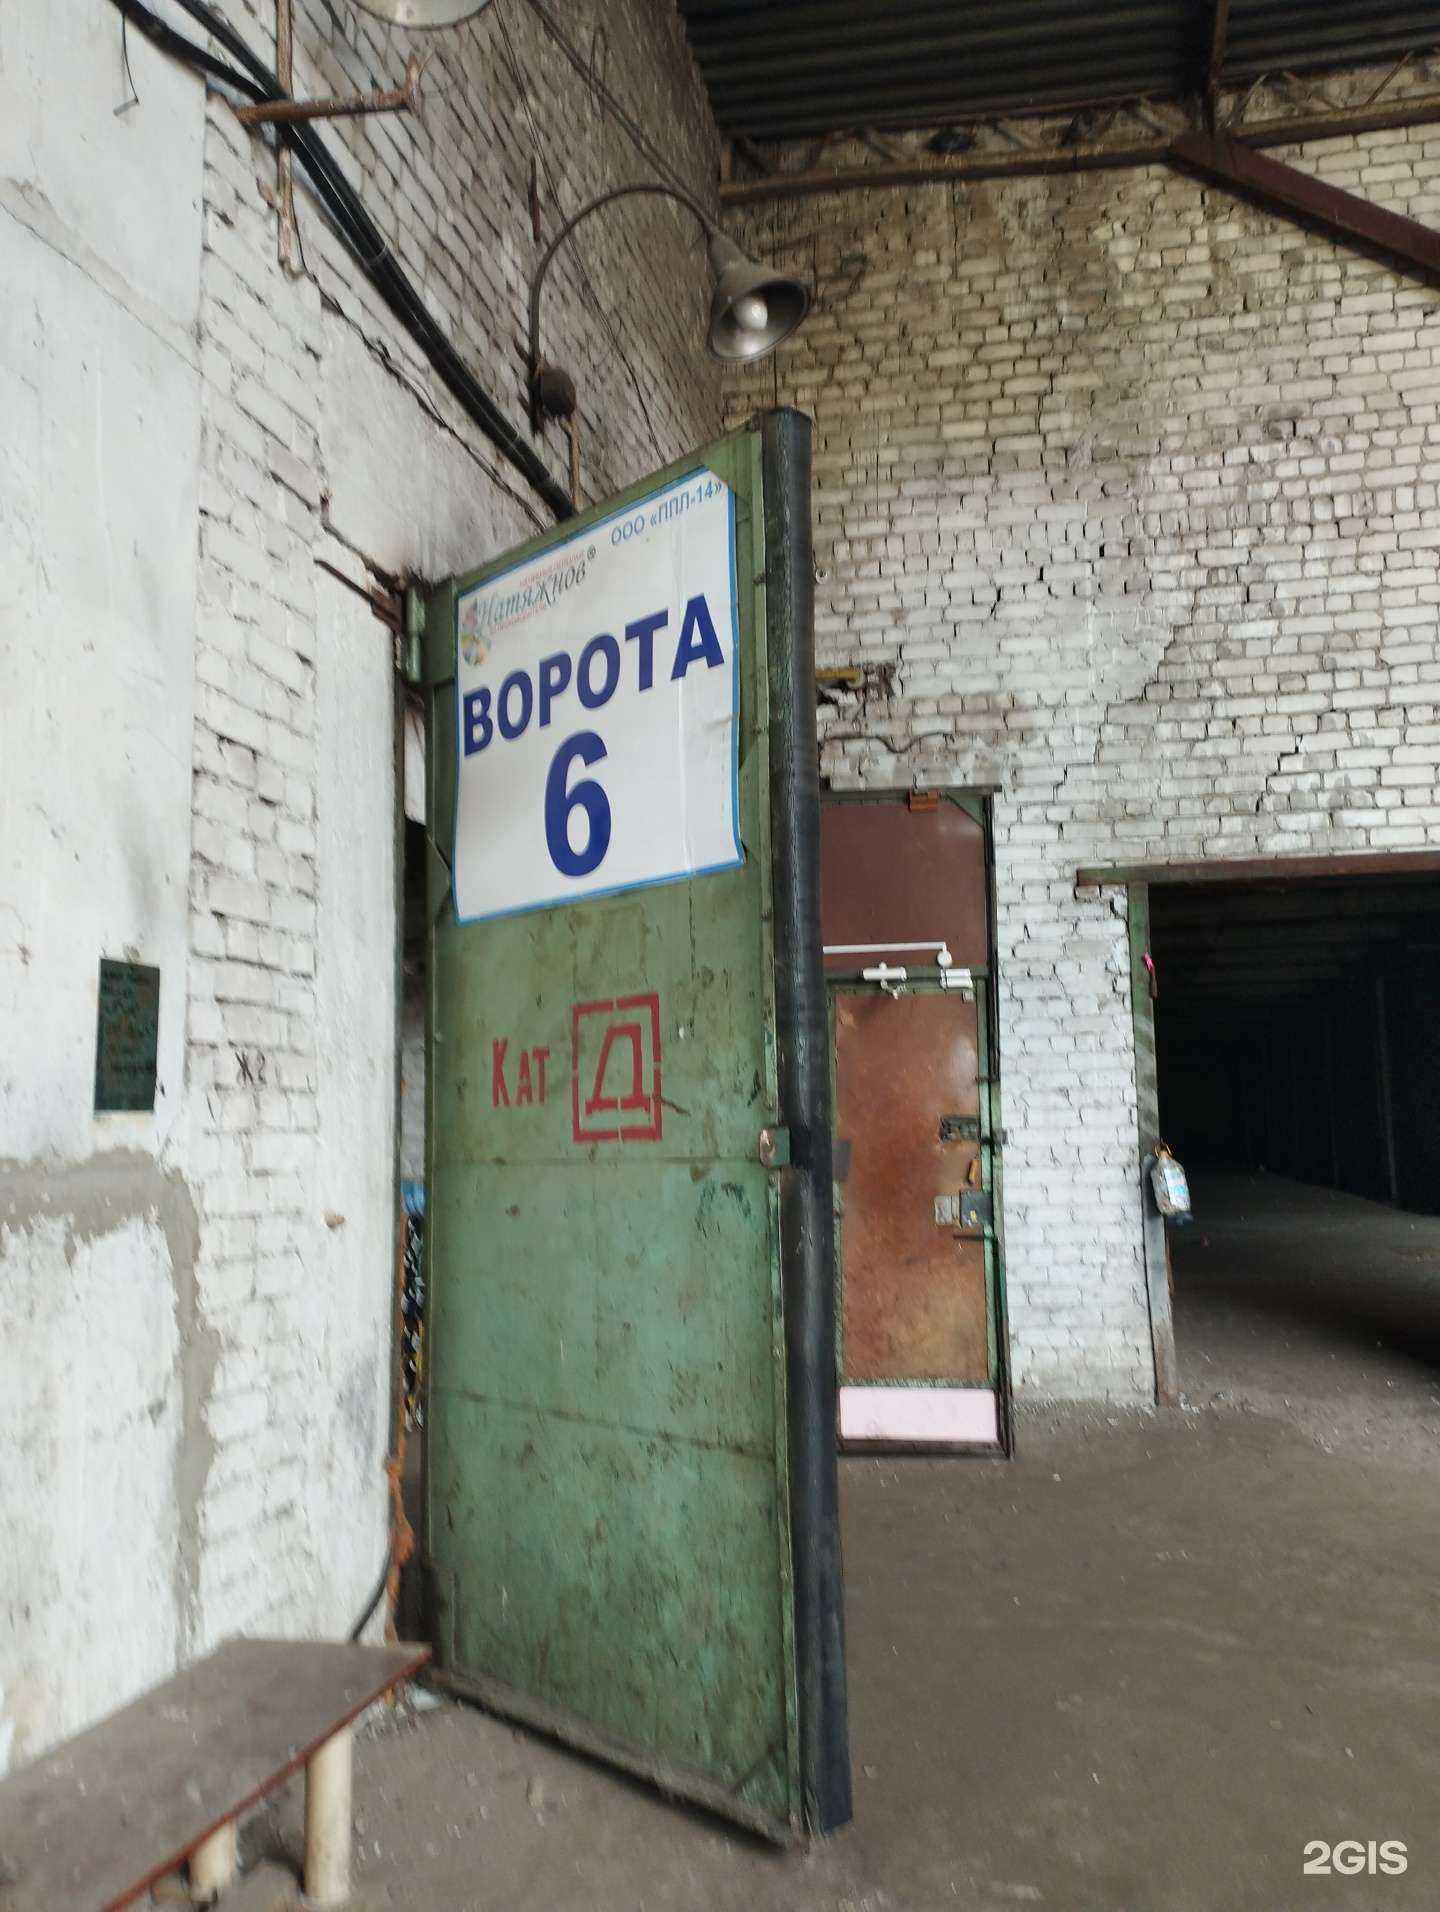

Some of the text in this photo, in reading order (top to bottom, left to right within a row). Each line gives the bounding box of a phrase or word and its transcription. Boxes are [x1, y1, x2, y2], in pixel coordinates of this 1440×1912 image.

[611, 515, 645, 546] ООО
[463, 593, 725, 757] ВОРОТА
[544, 731, 612, 877] 6
[585, 1022, 651, 1116] Д
